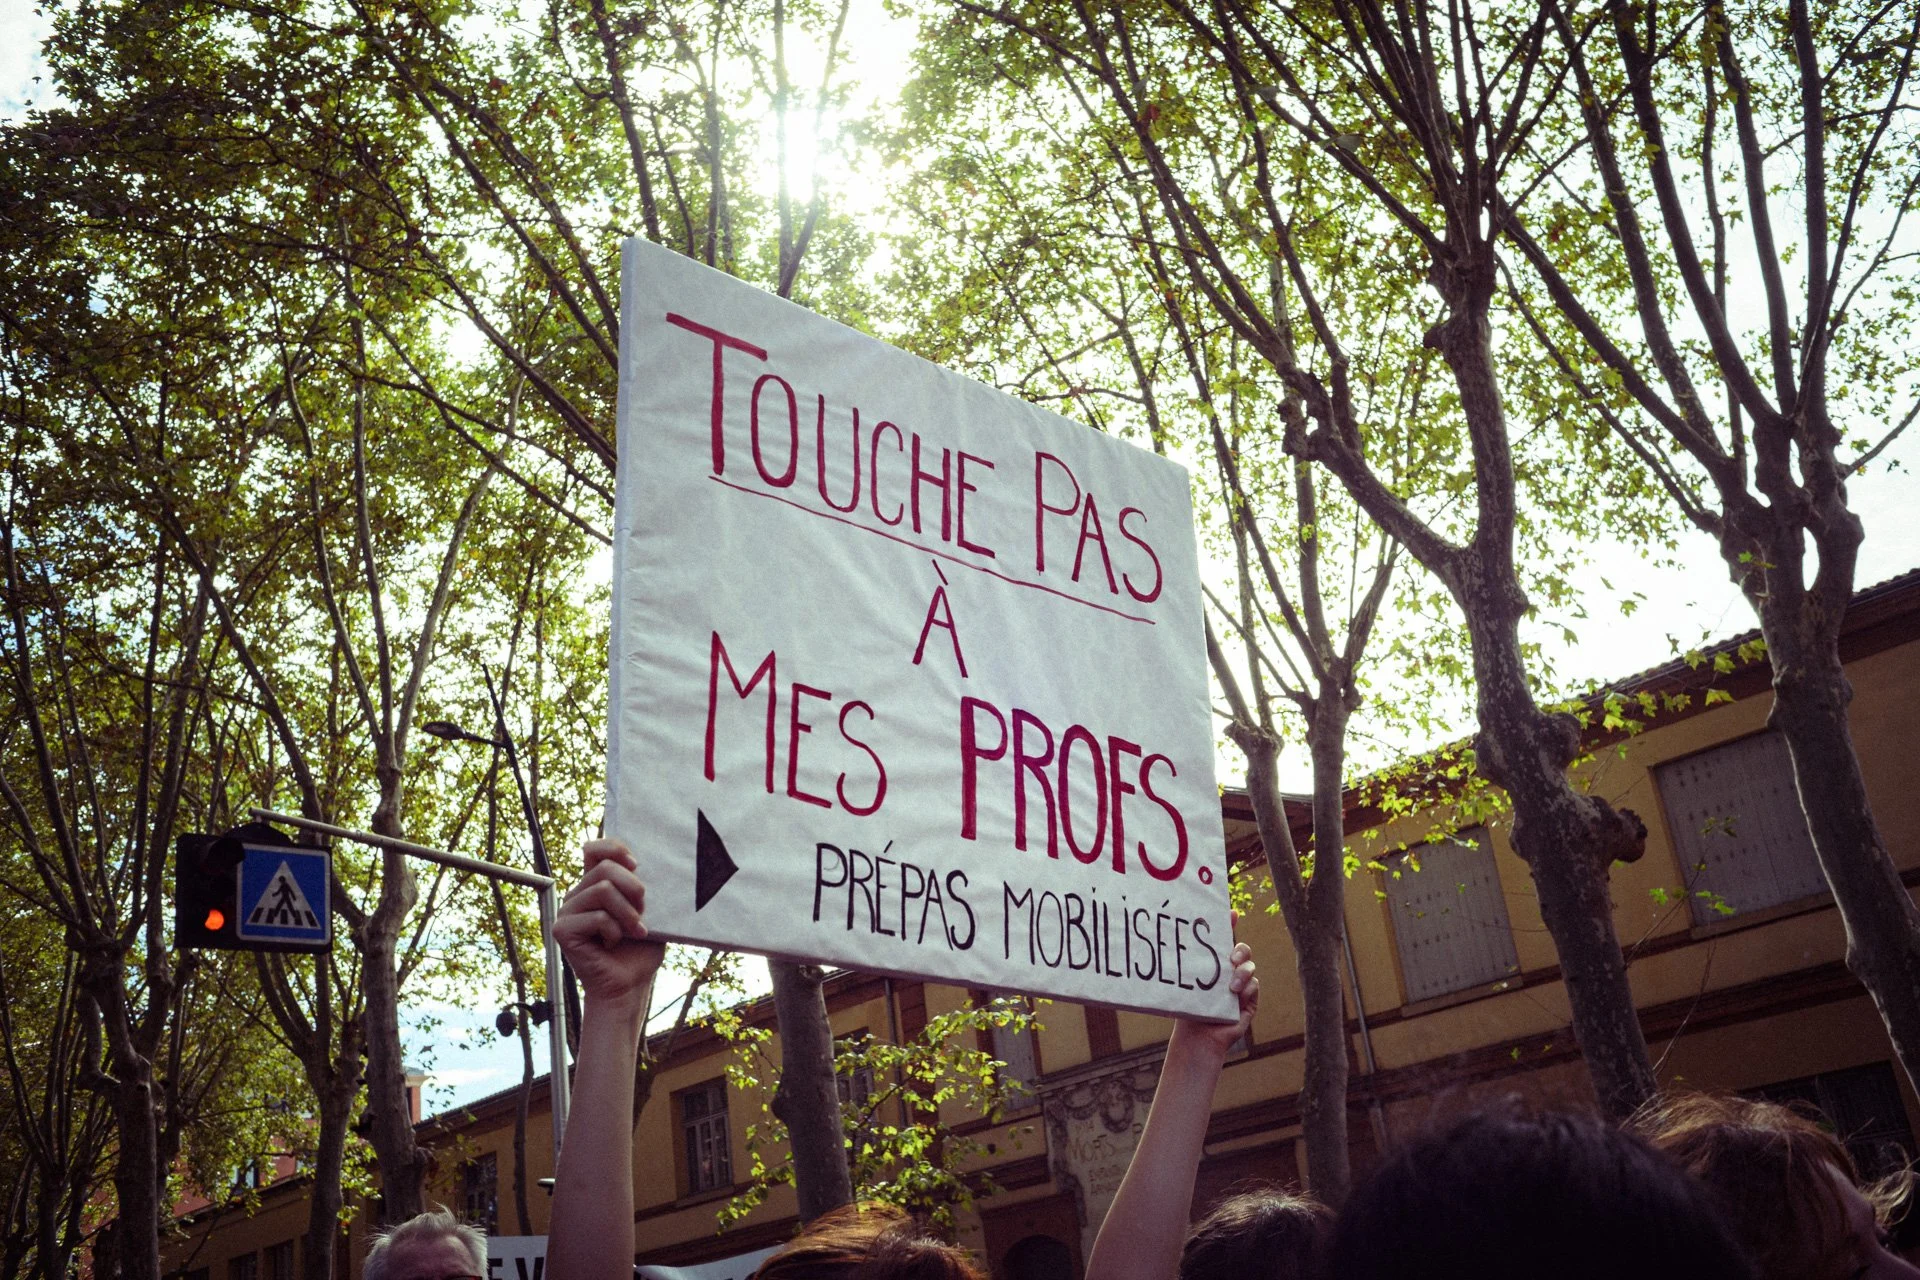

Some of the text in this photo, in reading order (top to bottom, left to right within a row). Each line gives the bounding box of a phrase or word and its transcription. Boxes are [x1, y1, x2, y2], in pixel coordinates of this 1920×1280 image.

[666, 311, 1163, 603] TOUCHE PAS
[912, 558, 968, 678] À
[704, 630, 888, 817] MES
[812, 839, 1221, 991] PRÉPAS MOBILISÉES
